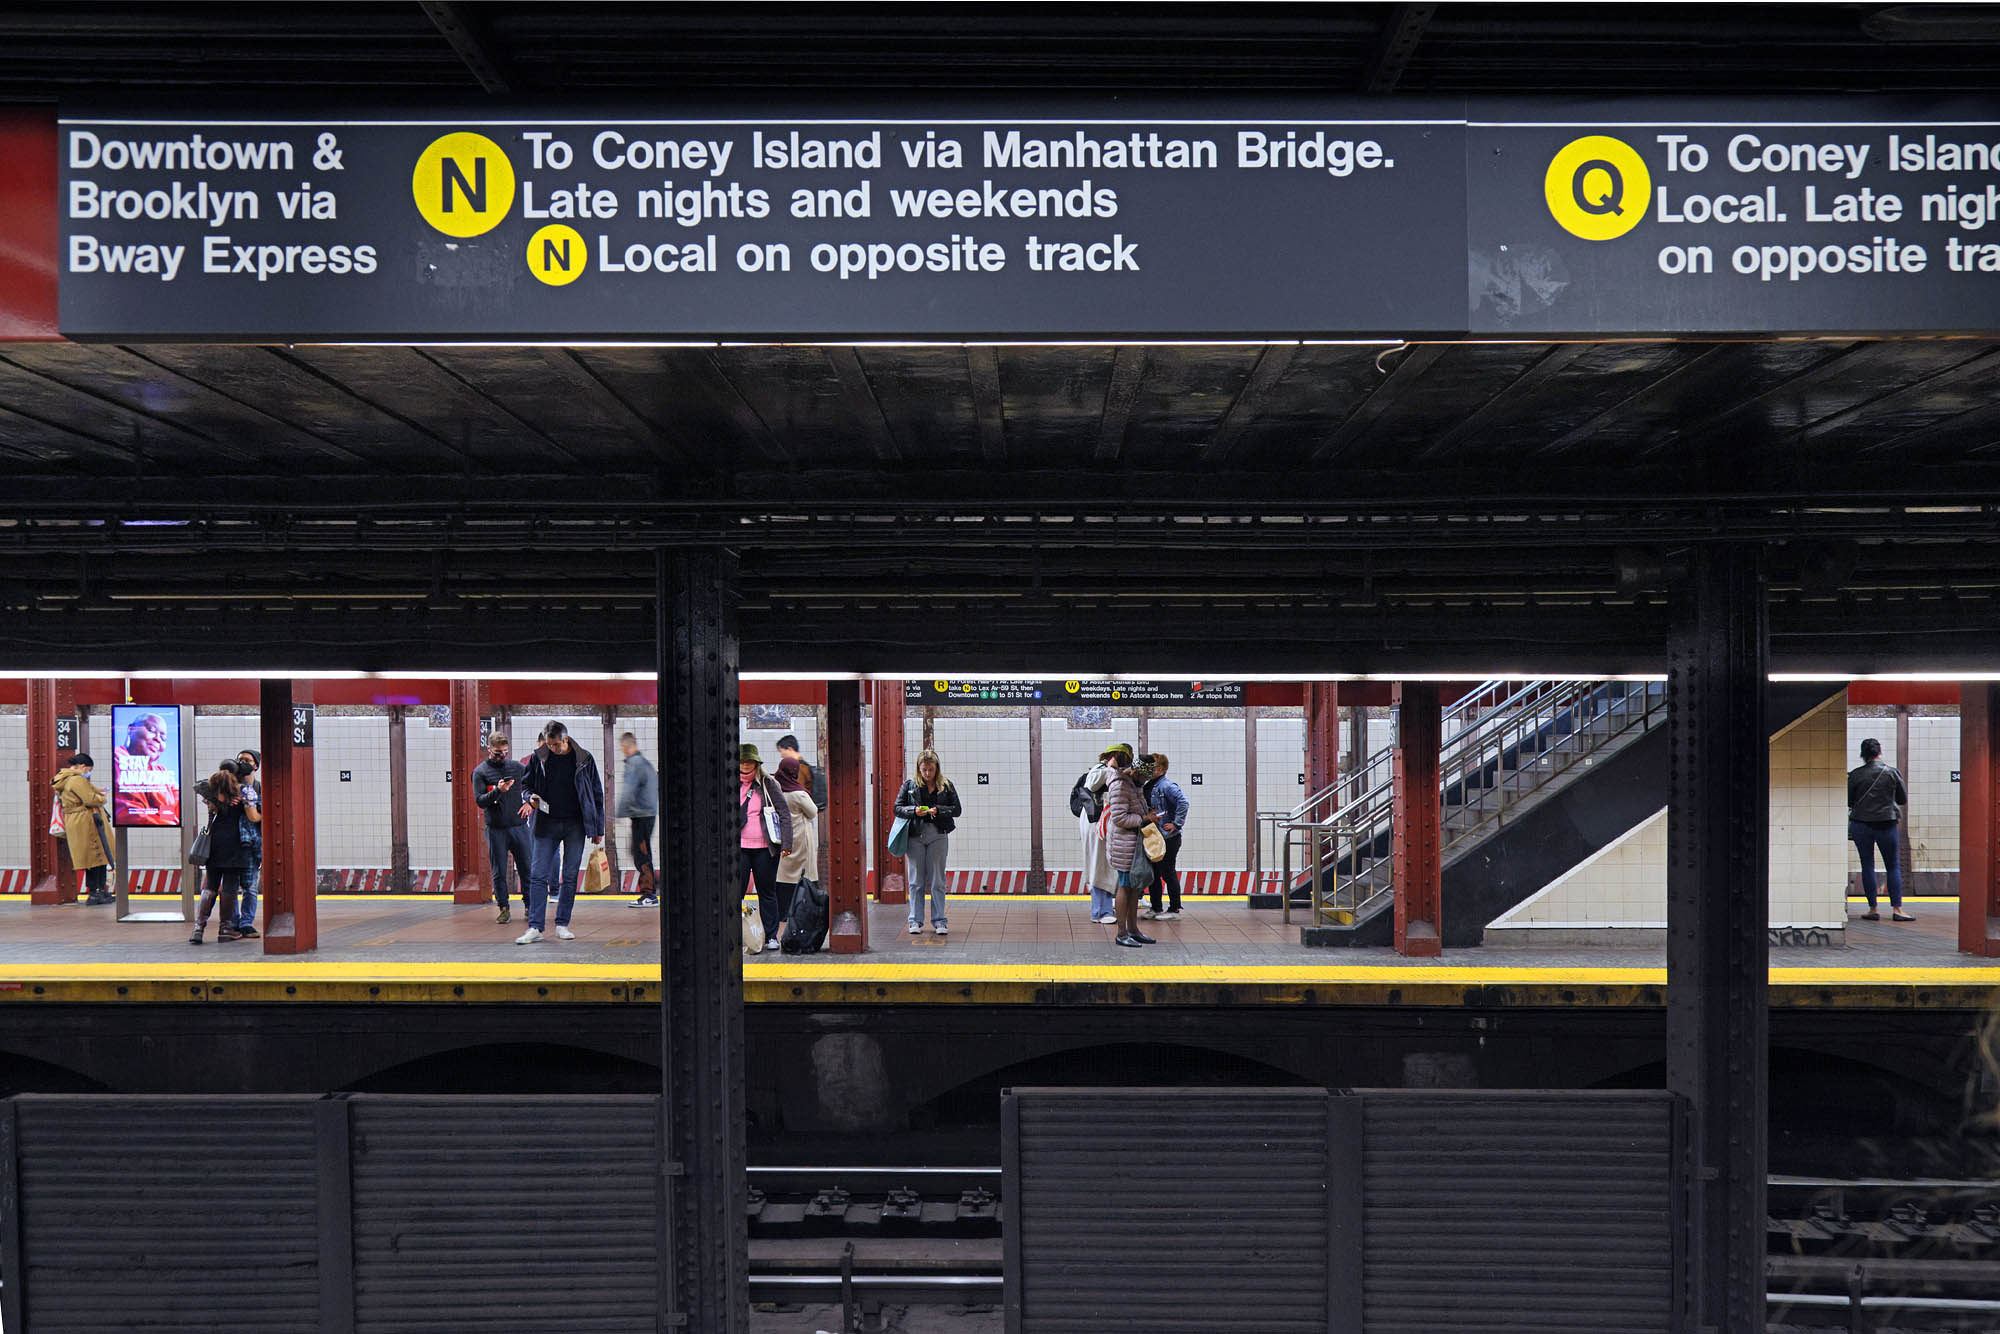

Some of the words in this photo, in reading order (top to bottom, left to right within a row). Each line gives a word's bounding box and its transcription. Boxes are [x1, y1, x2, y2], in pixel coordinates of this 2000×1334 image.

[70, 131, 293, 170] Downtown
[313, 132, 344, 170] &
[523, 132, 573, 169] To
[593, 131, 733, 177] Coney
[754, 131, 880, 169] Island
[901, 131, 962, 168] via
[984, 131, 1217, 168] Manhattan
[1238, 131, 1393, 176] Bridge.
[1657, 134, 1708, 172] To
[1728, 134, 1869, 178] Coney
[70, 181, 258, 226] Brooklyn
[278, 182, 336, 219] via
[442, 158, 486, 212] N
[524, 182, 618, 218] Late
[639, 181, 770, 227] nights
[791, 181, 870, 218] and
[890, 180, 1117, 217] weekends
[1573, 160, 1623, 217] Q
[1658, 186, 1786, 223] Local.
[1806, 185, 1902, 223] Late
[70, 236, 184, 280] Bway
[204, 237, 377, 281] Express
[544, 240, 569, 271] N
[600, 235, 716, 272] Local
[737, 243, 790, 272] on
[811, 235, 1005, 280] opposite
[1026, 234, 1139, 271] track
[1658, 245, 1712, 274] on
[1732, 237, 1926, 281] opposite
[1946, 237, 2000, 272] tra
[58, 721, 71, 733] 34
[293, 709, 307, 726] 34
[293, 727, 305, 743] St
[480, 721, 488, 733] 34
[58, 734, 69, 747] St
[119, 756, 150, 770] STAY
[119, 770, 177, 785] AMAZING
